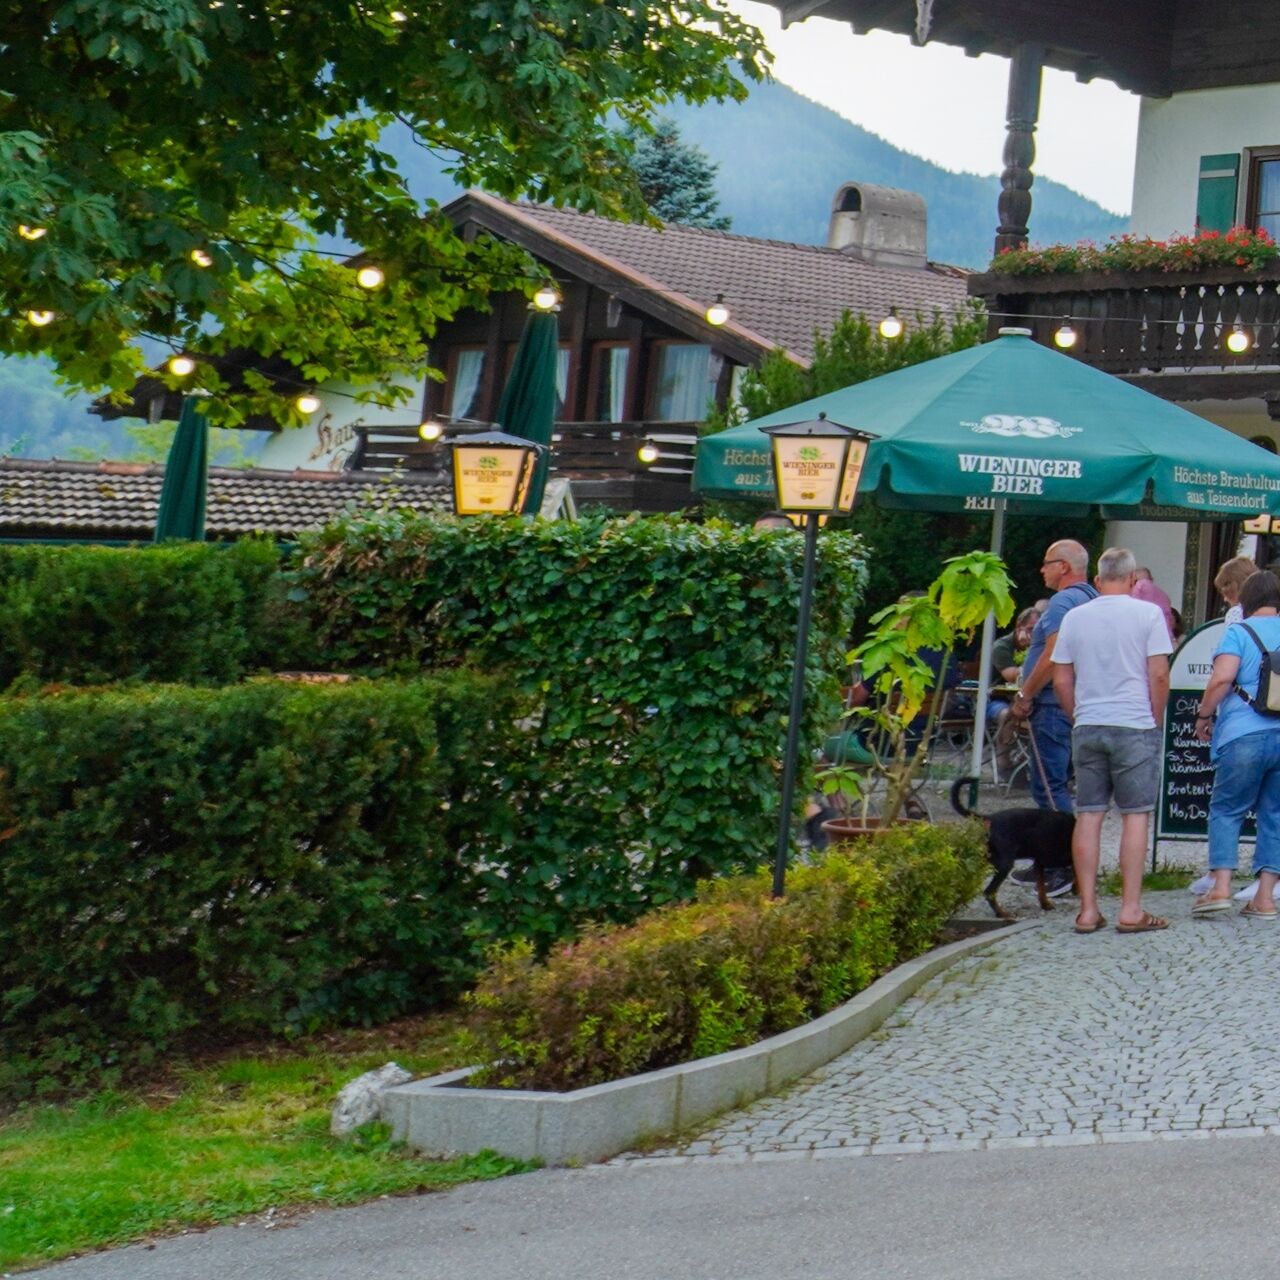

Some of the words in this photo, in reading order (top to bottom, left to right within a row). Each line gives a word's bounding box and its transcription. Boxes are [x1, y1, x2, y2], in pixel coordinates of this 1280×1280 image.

[723, 449, 772, 466] Höchst
[783, 461, 835, 469] WIENINGER
[958, 454, 1082, 478] WIENINGER
[735, 472, 760, 485] aus
[992, 475, 1043, 495] BIER
[1174, 466, 1218, 486] Höchste
[1187, 491, 1205, 504] aus
[1207, 489, 1269, 509] Teisendorf.
